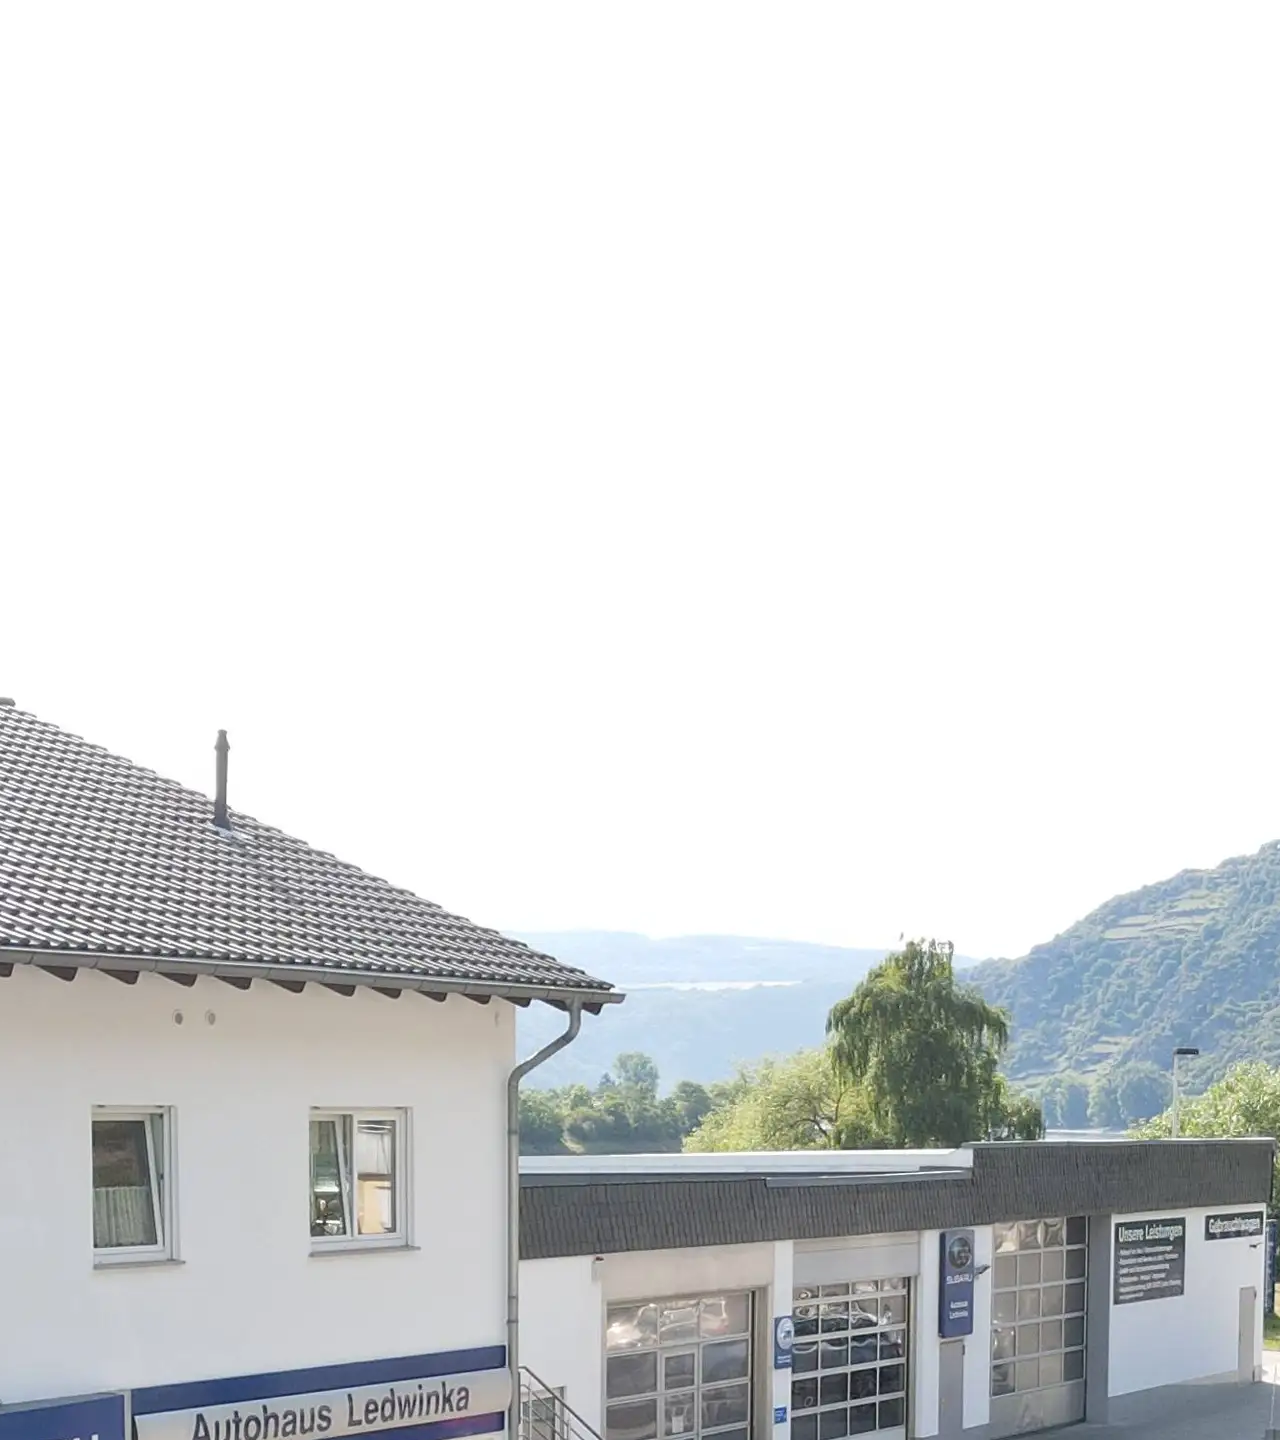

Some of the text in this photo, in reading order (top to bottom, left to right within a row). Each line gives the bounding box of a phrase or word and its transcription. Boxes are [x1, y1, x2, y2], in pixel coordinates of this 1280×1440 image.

[1118, 1222, 1183, 1243] Unsere Leistungen
[347, 1380, 471, 1428] Ledwinka
